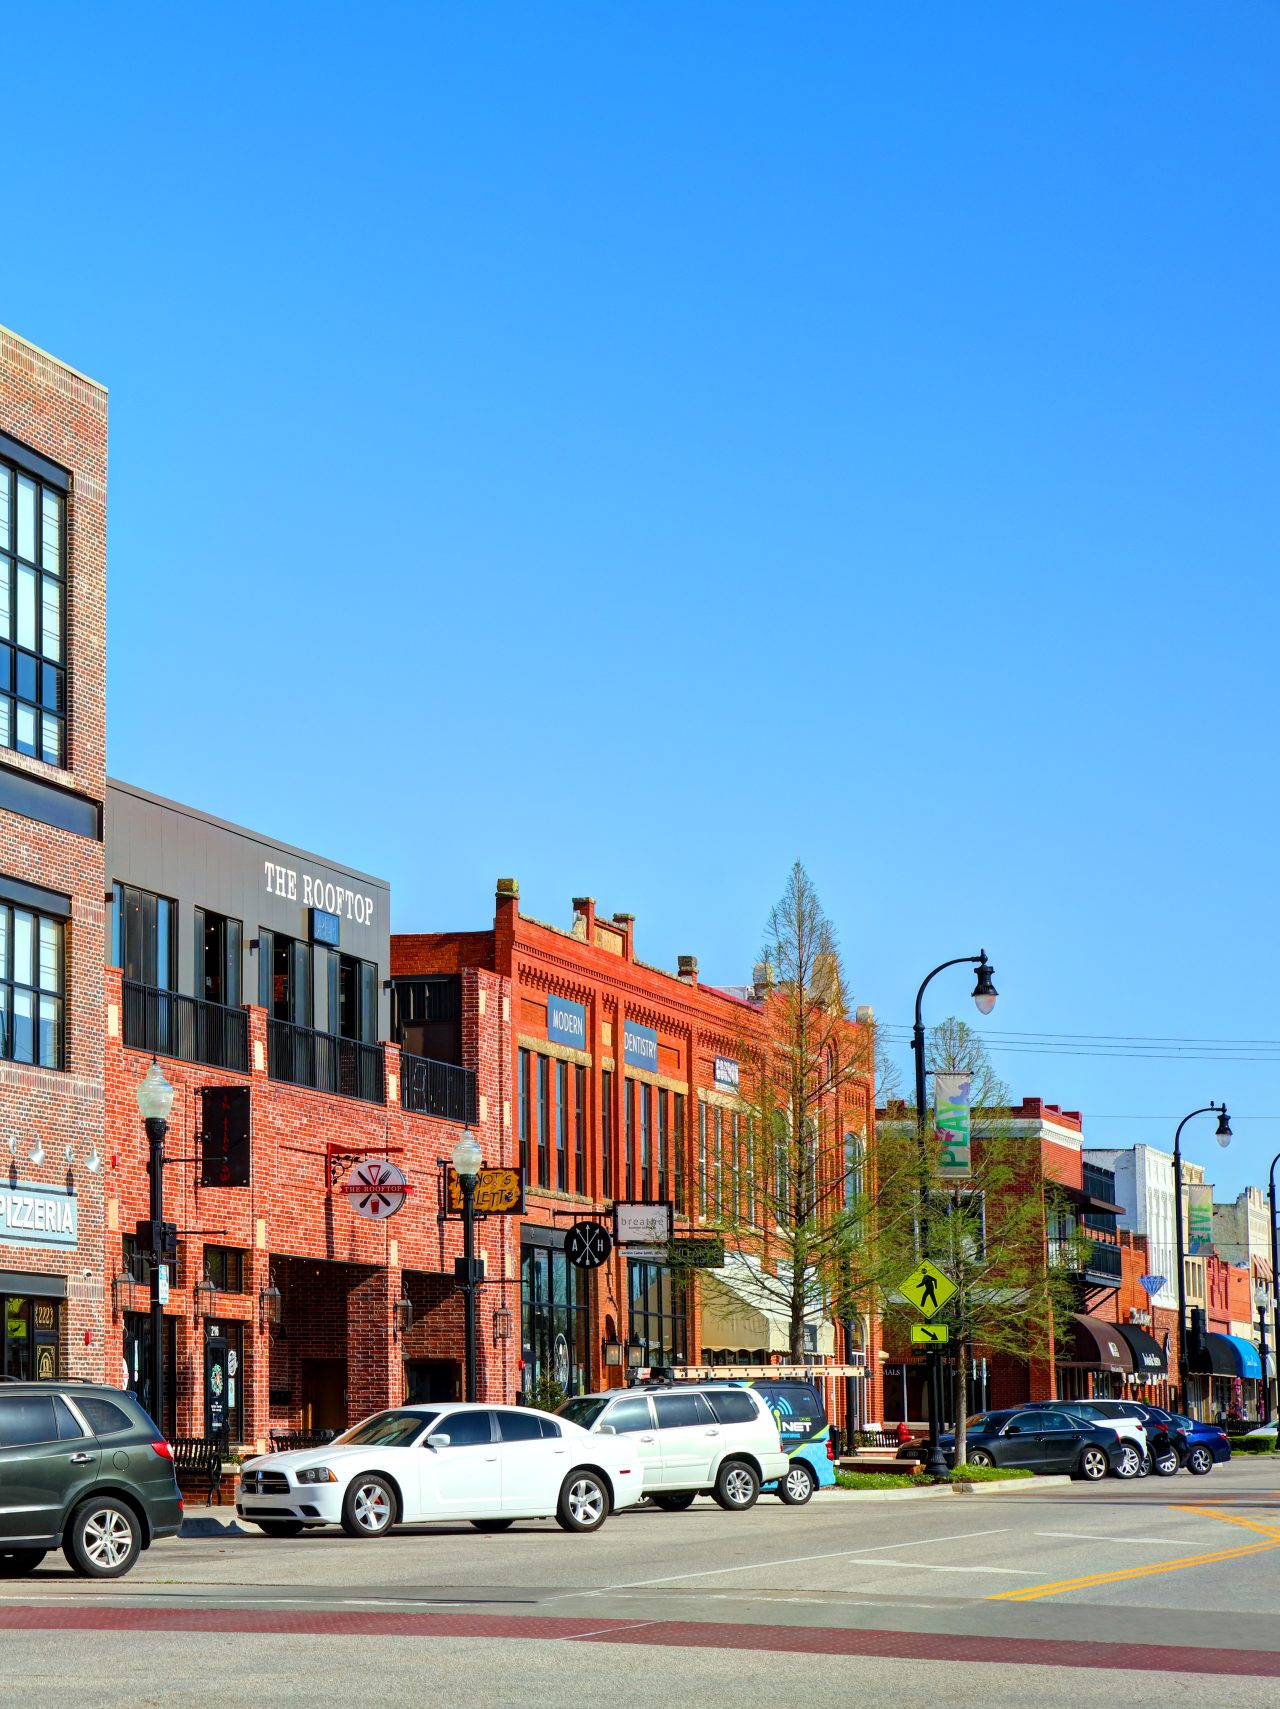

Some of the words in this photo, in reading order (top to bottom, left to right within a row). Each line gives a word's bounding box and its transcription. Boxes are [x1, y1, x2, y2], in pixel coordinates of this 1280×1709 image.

[264, 861, 297, 901] THE
[302, 874, 373, 926] ROOFTOP
[552, 1008, 583, 1036] MODERN
[624, 1031, 657, 1060] DENTISTRY
[936, 1100, 969, 1167] PLAY
[363, 1185, 402, 1193] ROOFTOP
[621, 1217, 665, 1226] breathe
[571, 1239, 578, 1252] A
[597, 1238, 604, 1252] H
[781, 1421, 812, 1432] NET
